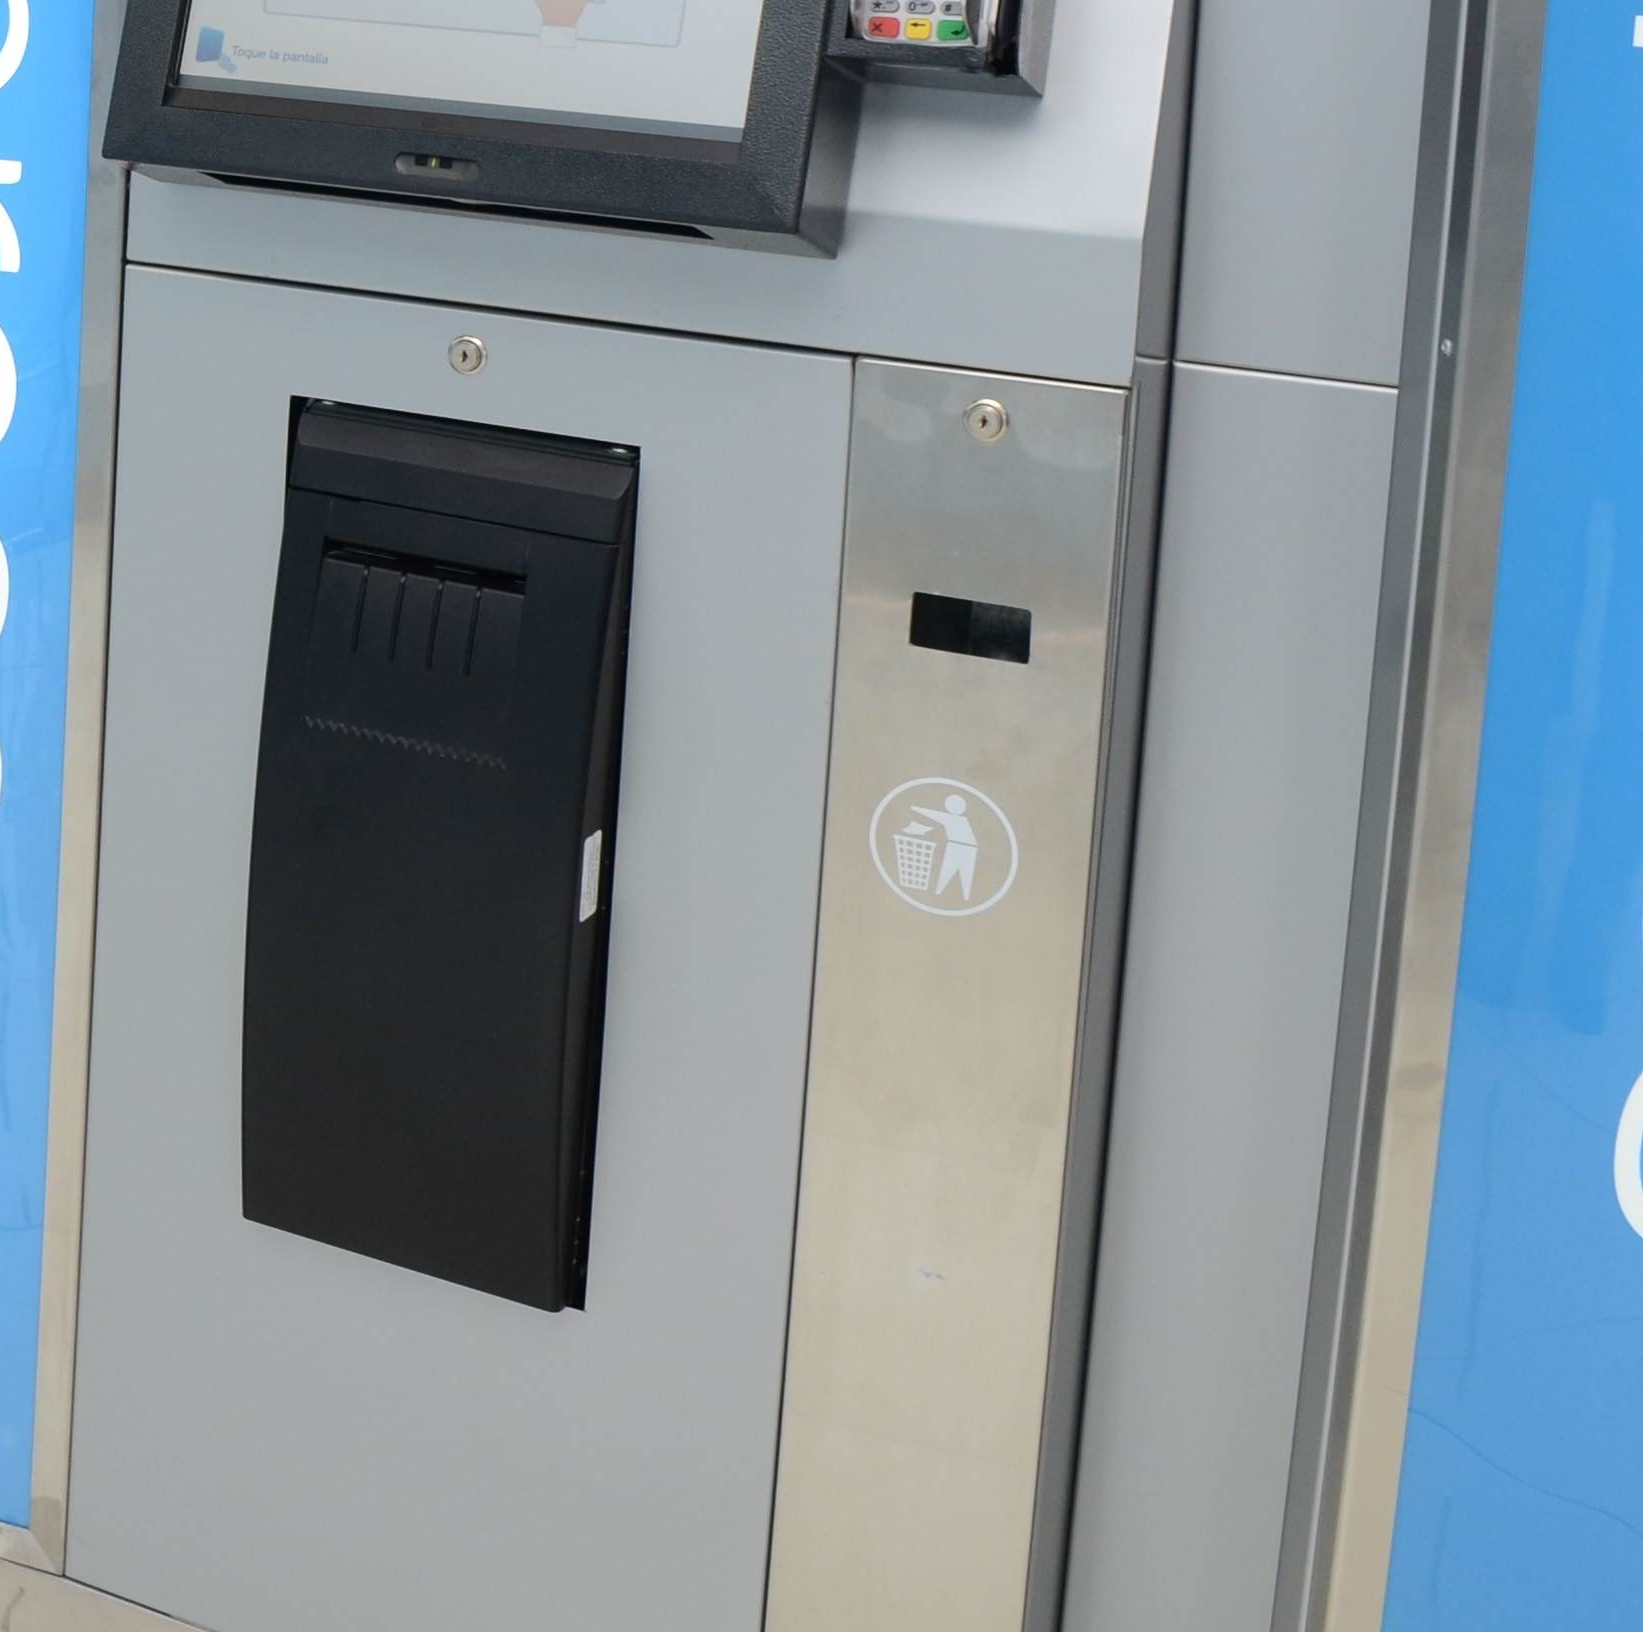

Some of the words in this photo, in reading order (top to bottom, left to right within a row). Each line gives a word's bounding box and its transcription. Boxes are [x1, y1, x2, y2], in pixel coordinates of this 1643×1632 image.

[909, 2, 916, 11] 0
[232, 45, 266, 59] Toque
[269, 50, 279, 59] la
[282, 51, 329, 65] pantalla
